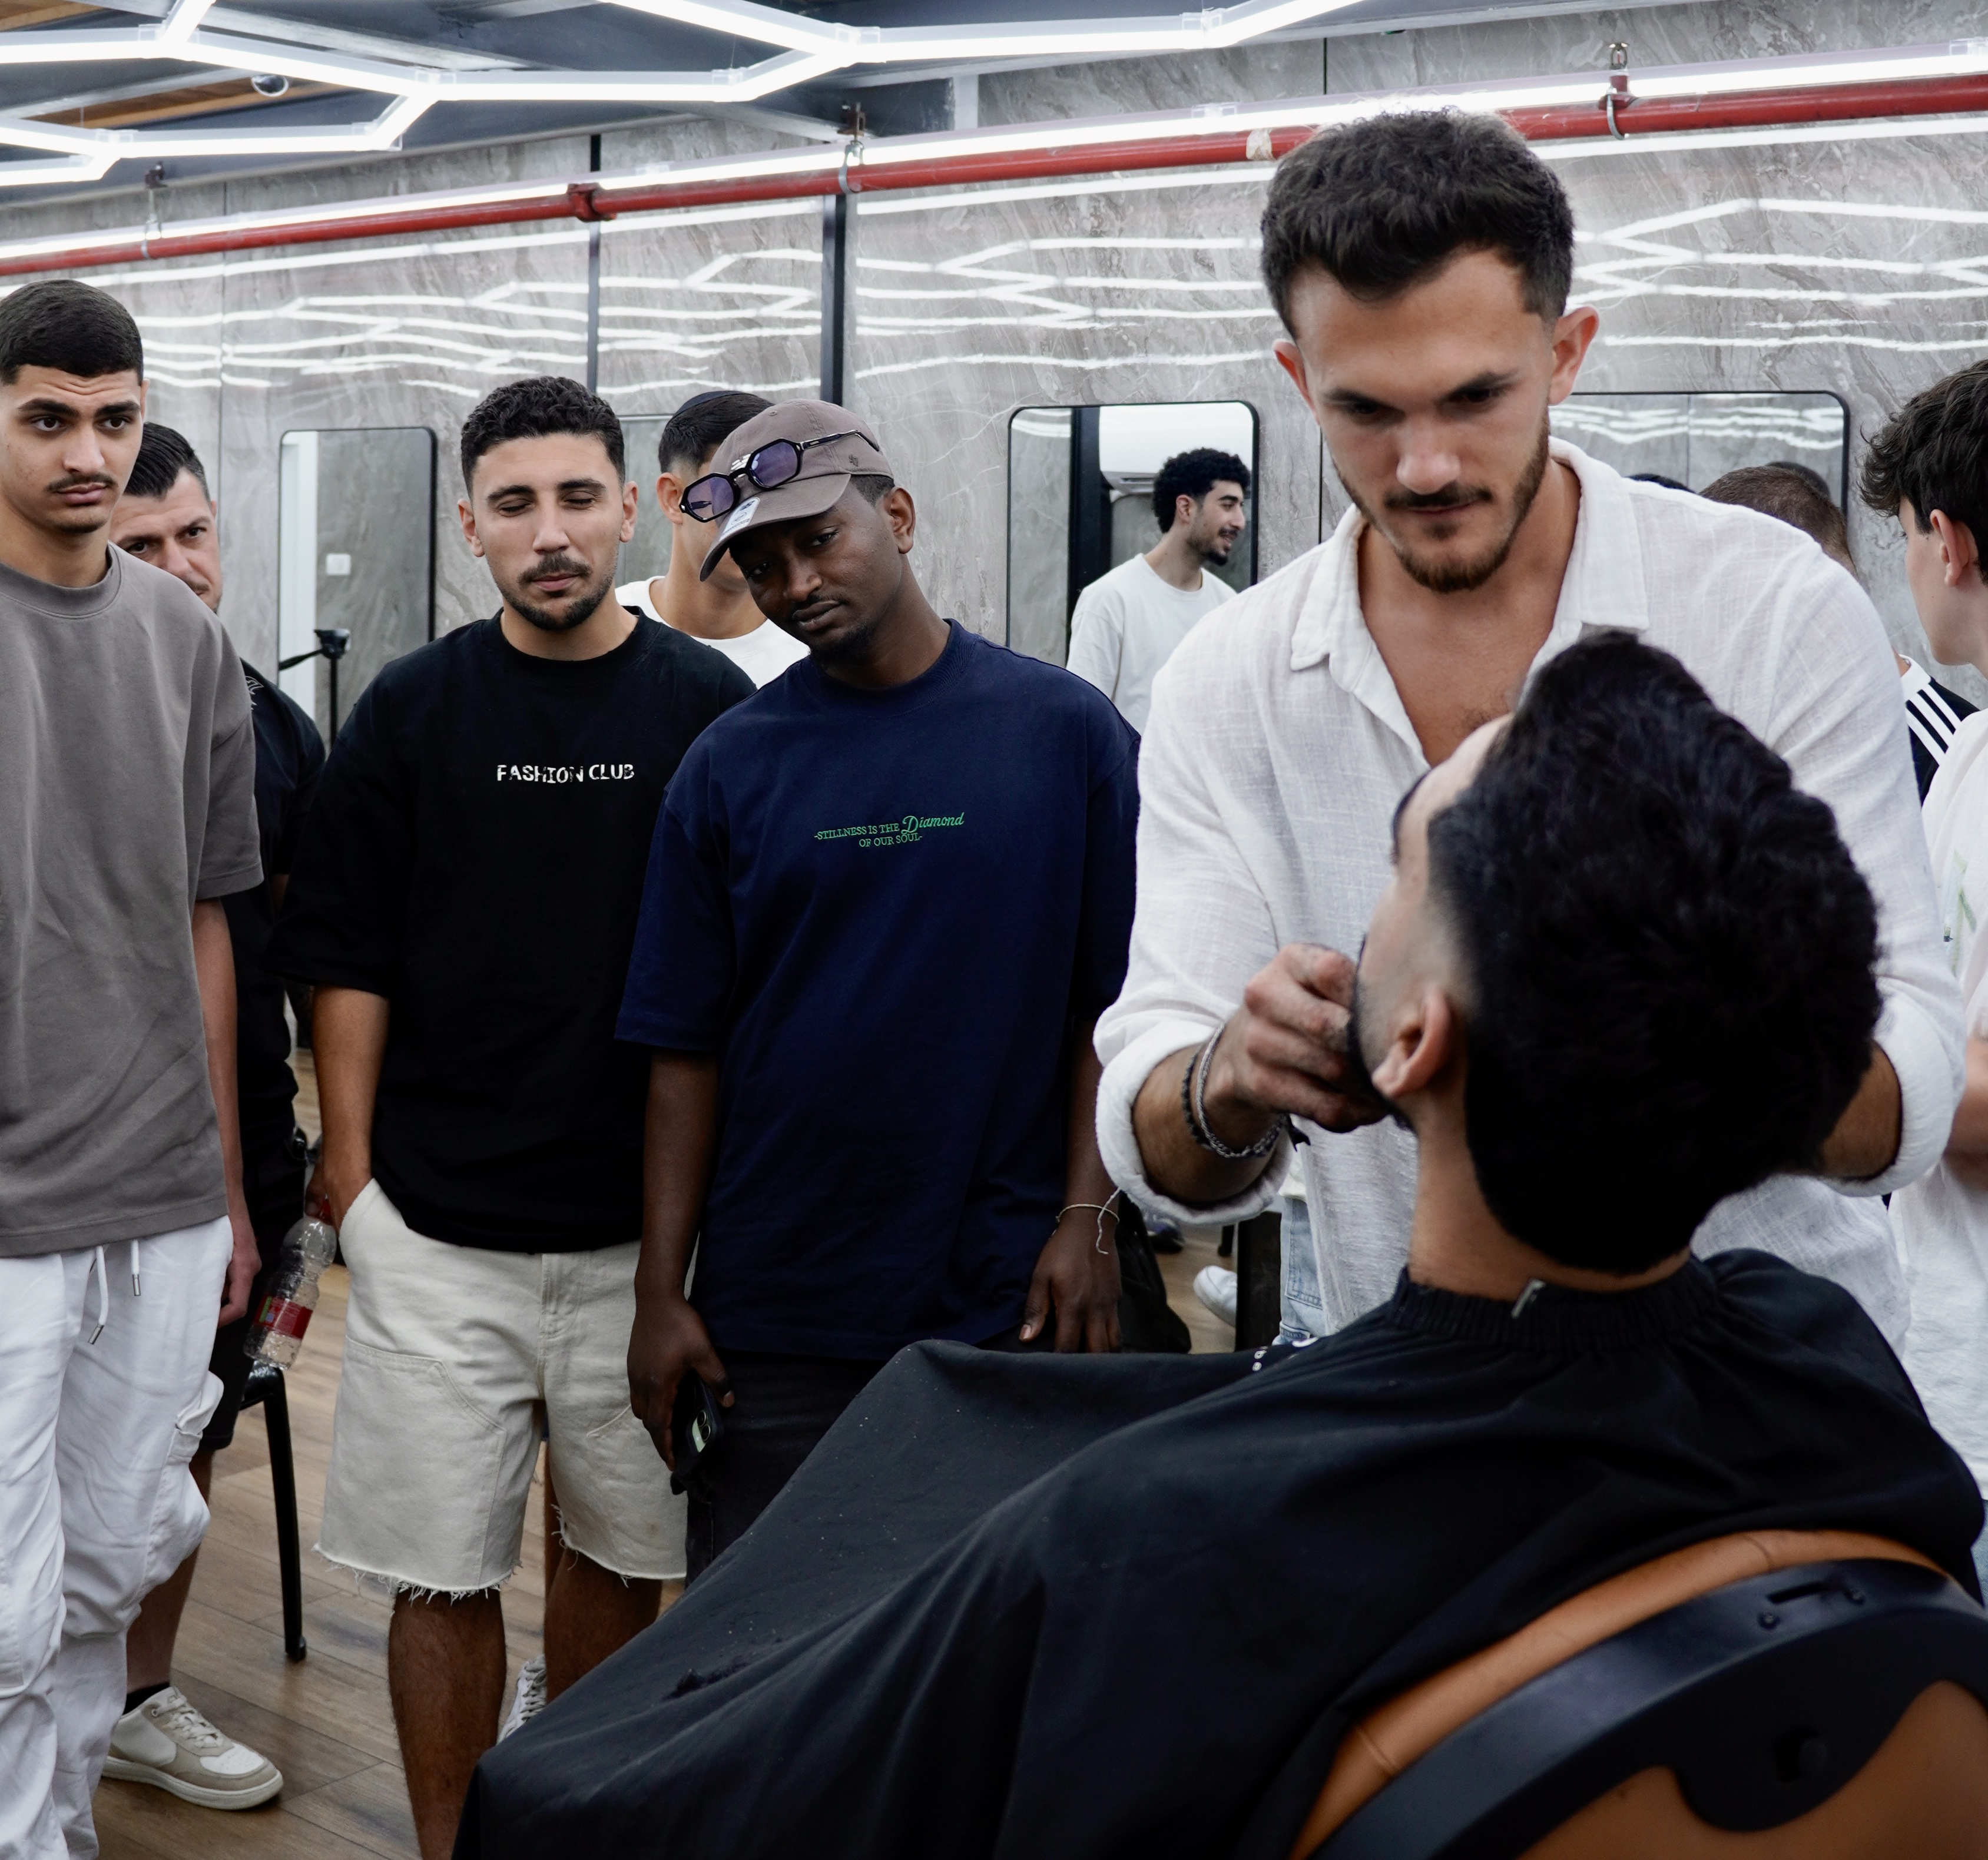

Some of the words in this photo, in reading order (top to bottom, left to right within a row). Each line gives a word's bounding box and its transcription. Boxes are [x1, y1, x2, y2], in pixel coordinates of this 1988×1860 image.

[497, 765, 584, 783] FASHION
[589, 764, 635, 780] CLUB
[869, 825, 877, 834] IS
[879, 823, 900, 834] THE
[901, 812, 965, 835] Diamond
[859, 838, 872, 847] OF
[874, 836, 894, 847] OUR
